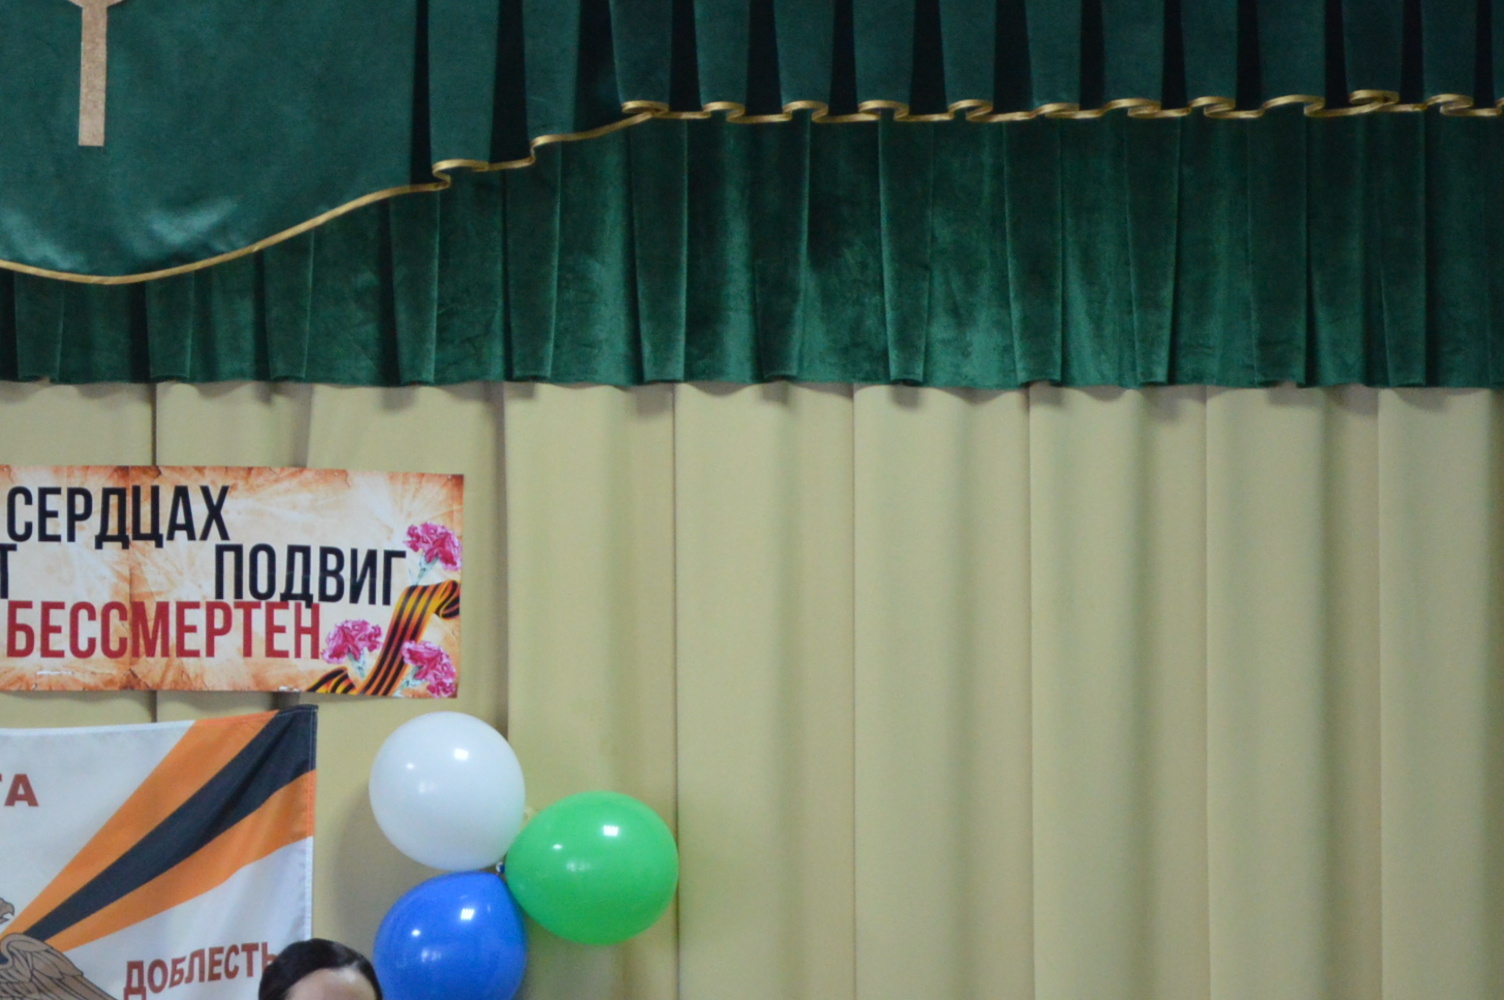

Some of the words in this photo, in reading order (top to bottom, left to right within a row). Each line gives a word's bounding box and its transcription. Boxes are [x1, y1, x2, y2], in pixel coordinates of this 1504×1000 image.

[6, 484, 230, 550] СЕРДЦАХ
[214, 543, 407, 608] ПОДВИГ
[6, 600, 321, 660] БЕССМЕРТЕН
